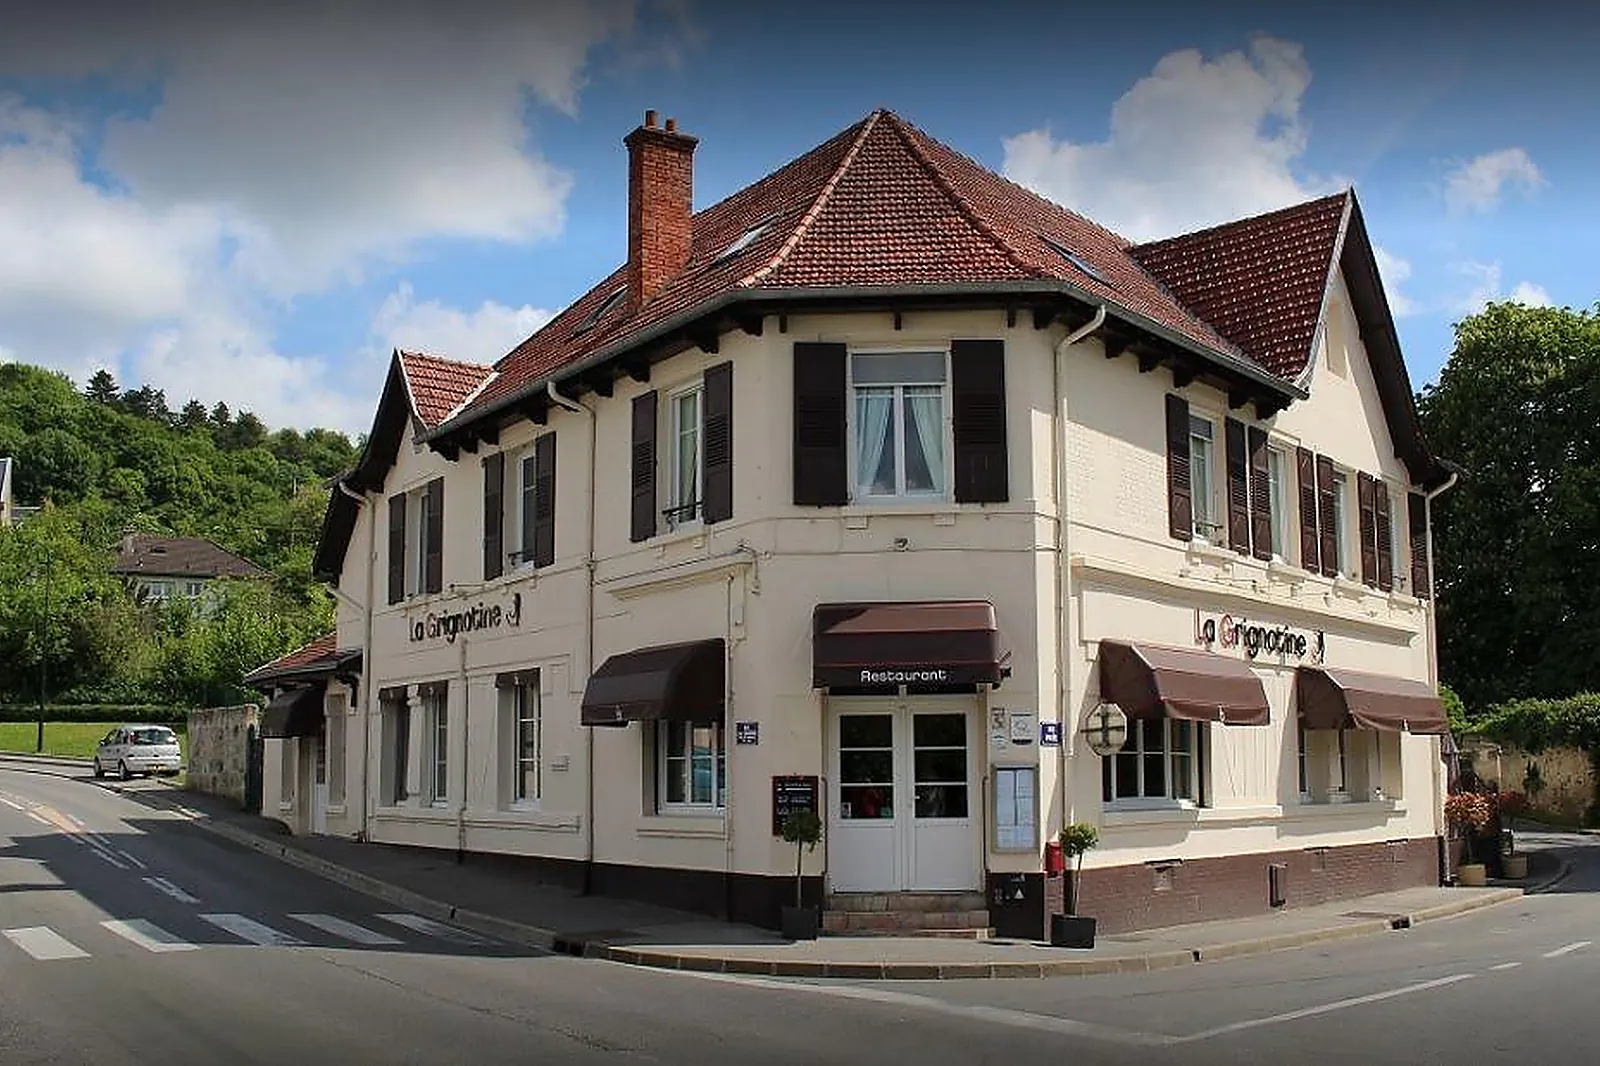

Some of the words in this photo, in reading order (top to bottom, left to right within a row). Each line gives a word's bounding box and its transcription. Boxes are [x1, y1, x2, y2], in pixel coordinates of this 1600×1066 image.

[408, 616, 424, 642] La
[427, 601, 501, 643] Grignotine
[1194, 608, 1216, 644] La
[1219, 614, 1307, 659] Grignotine
[860, 669, 948, 683] Restaurant
